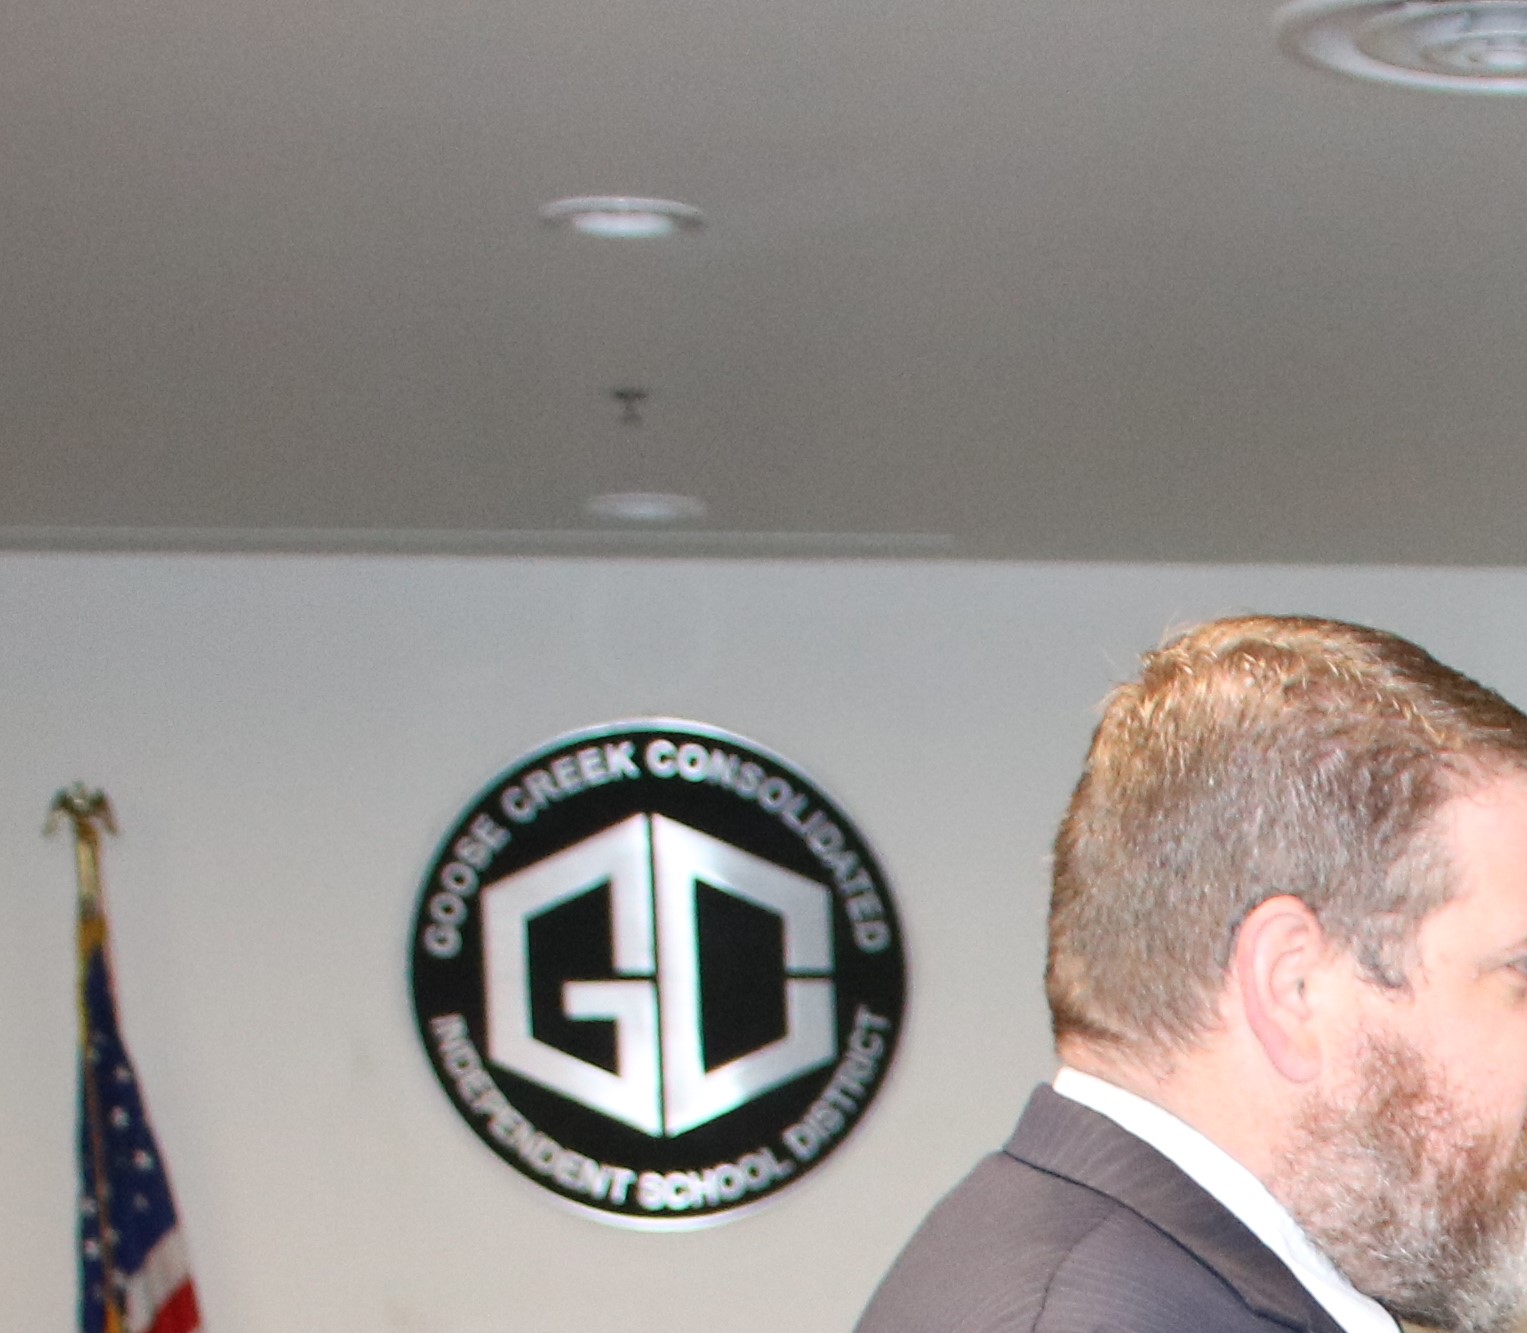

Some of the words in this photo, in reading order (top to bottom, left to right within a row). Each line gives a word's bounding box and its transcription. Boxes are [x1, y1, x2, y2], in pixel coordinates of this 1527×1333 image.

[423, 811, 512, 959] GOOSE
[501, 740, 641, 824] CREEK
[645, 739, 891, 953] CONSOLIDATED
[479, 811, 838, 1139] GC
[430, 1012, 638, 1205] INDEPENDENT
[637, 1147, 796, 1211] SCHOOL
[782, 1003, 892, 1163] DISTRICT
